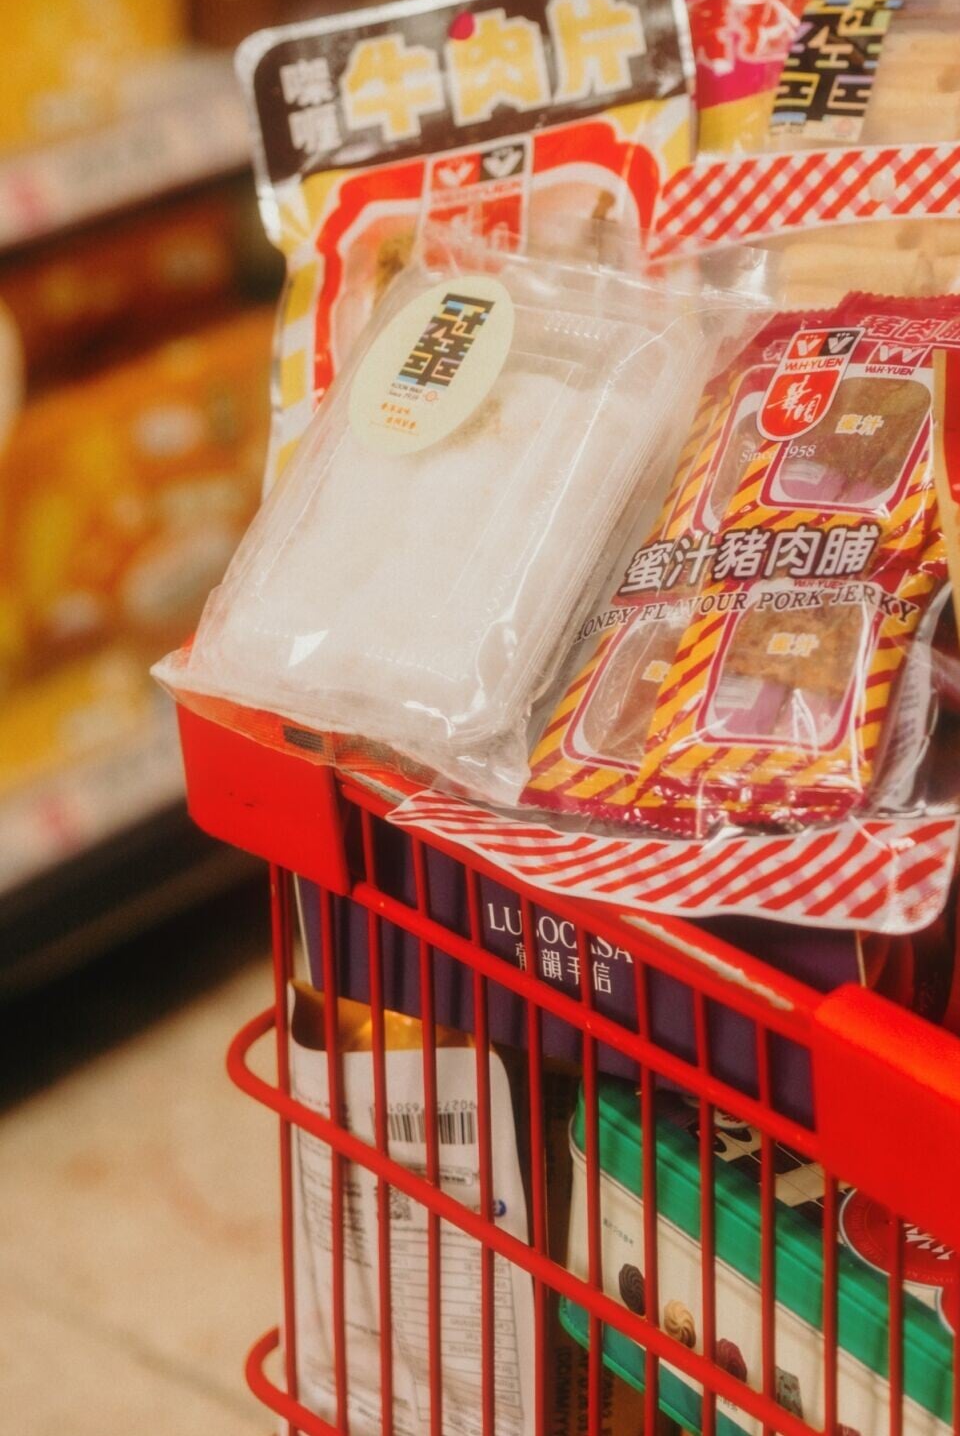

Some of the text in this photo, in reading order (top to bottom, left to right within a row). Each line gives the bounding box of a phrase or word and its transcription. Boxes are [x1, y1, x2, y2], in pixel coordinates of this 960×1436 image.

[740, 445, 817, 464] Since 1958
[617, 524, 880, 595] 蜜汁豬肉脯
[758, 589, 822, 611] PORK
[832, 584, 919, 623] JERKY
[487, 902, 634, 964] LUOCSA
